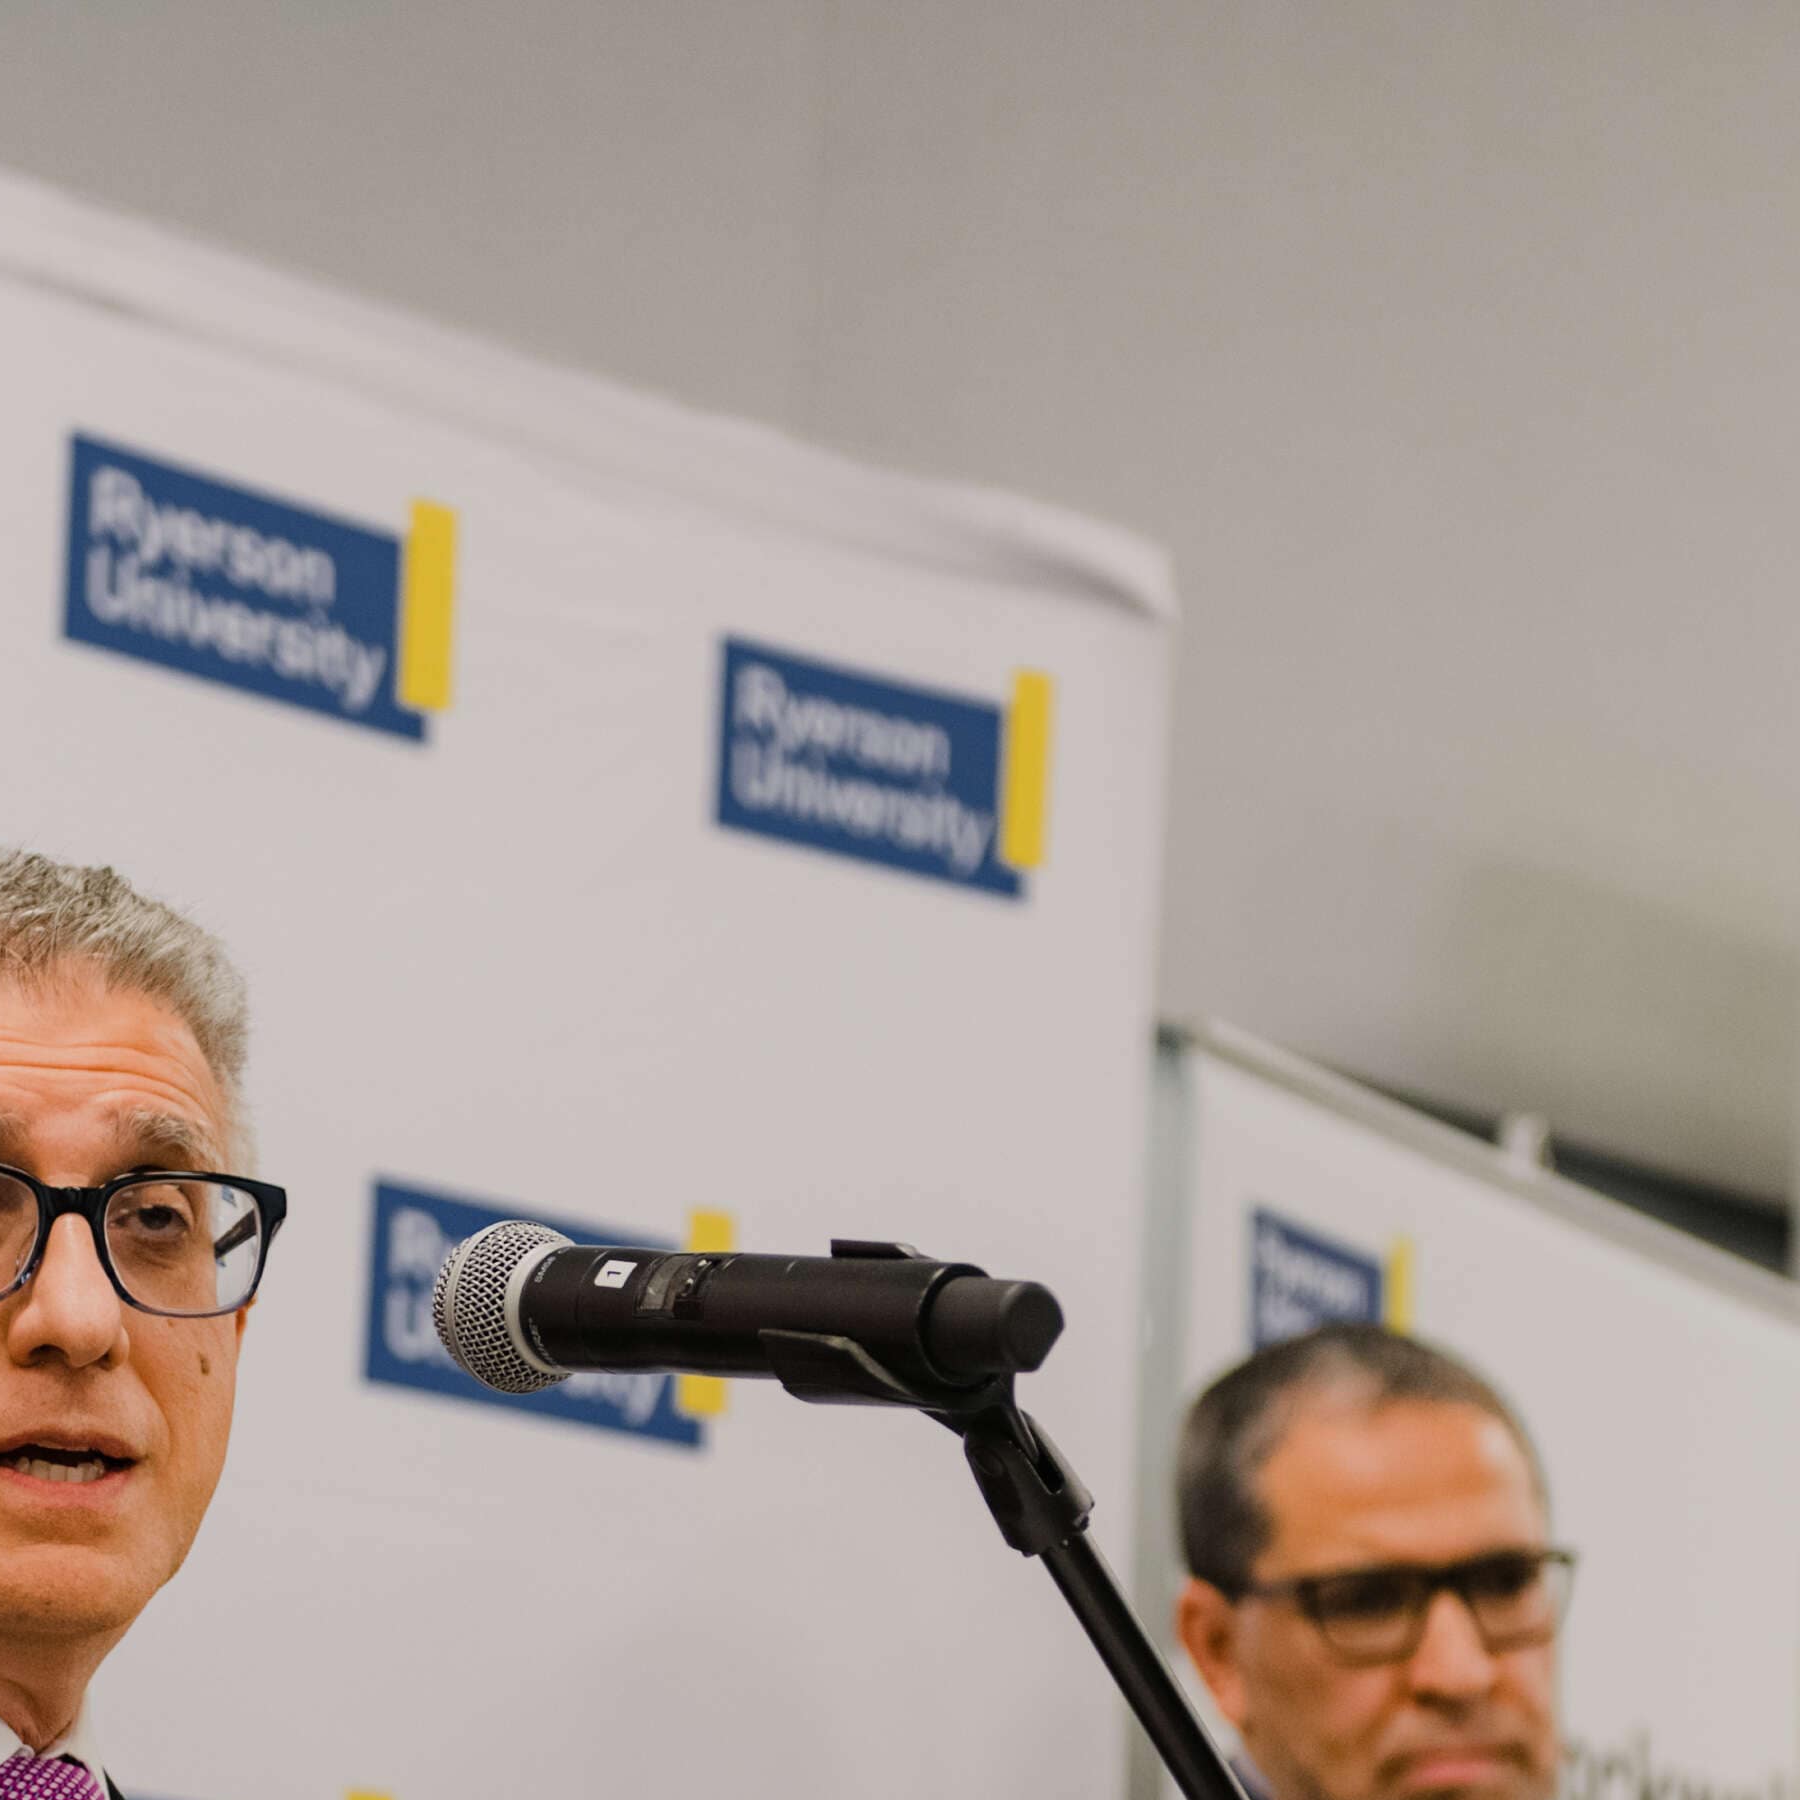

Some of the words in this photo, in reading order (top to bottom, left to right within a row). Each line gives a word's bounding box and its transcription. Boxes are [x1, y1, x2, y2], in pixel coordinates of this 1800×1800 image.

[88, 465, 337, 607] Ryerson
[85, 545, 388, 712] University
[734, 663, 950, 778] Ryerson
[730, 738, 997, 874] University
